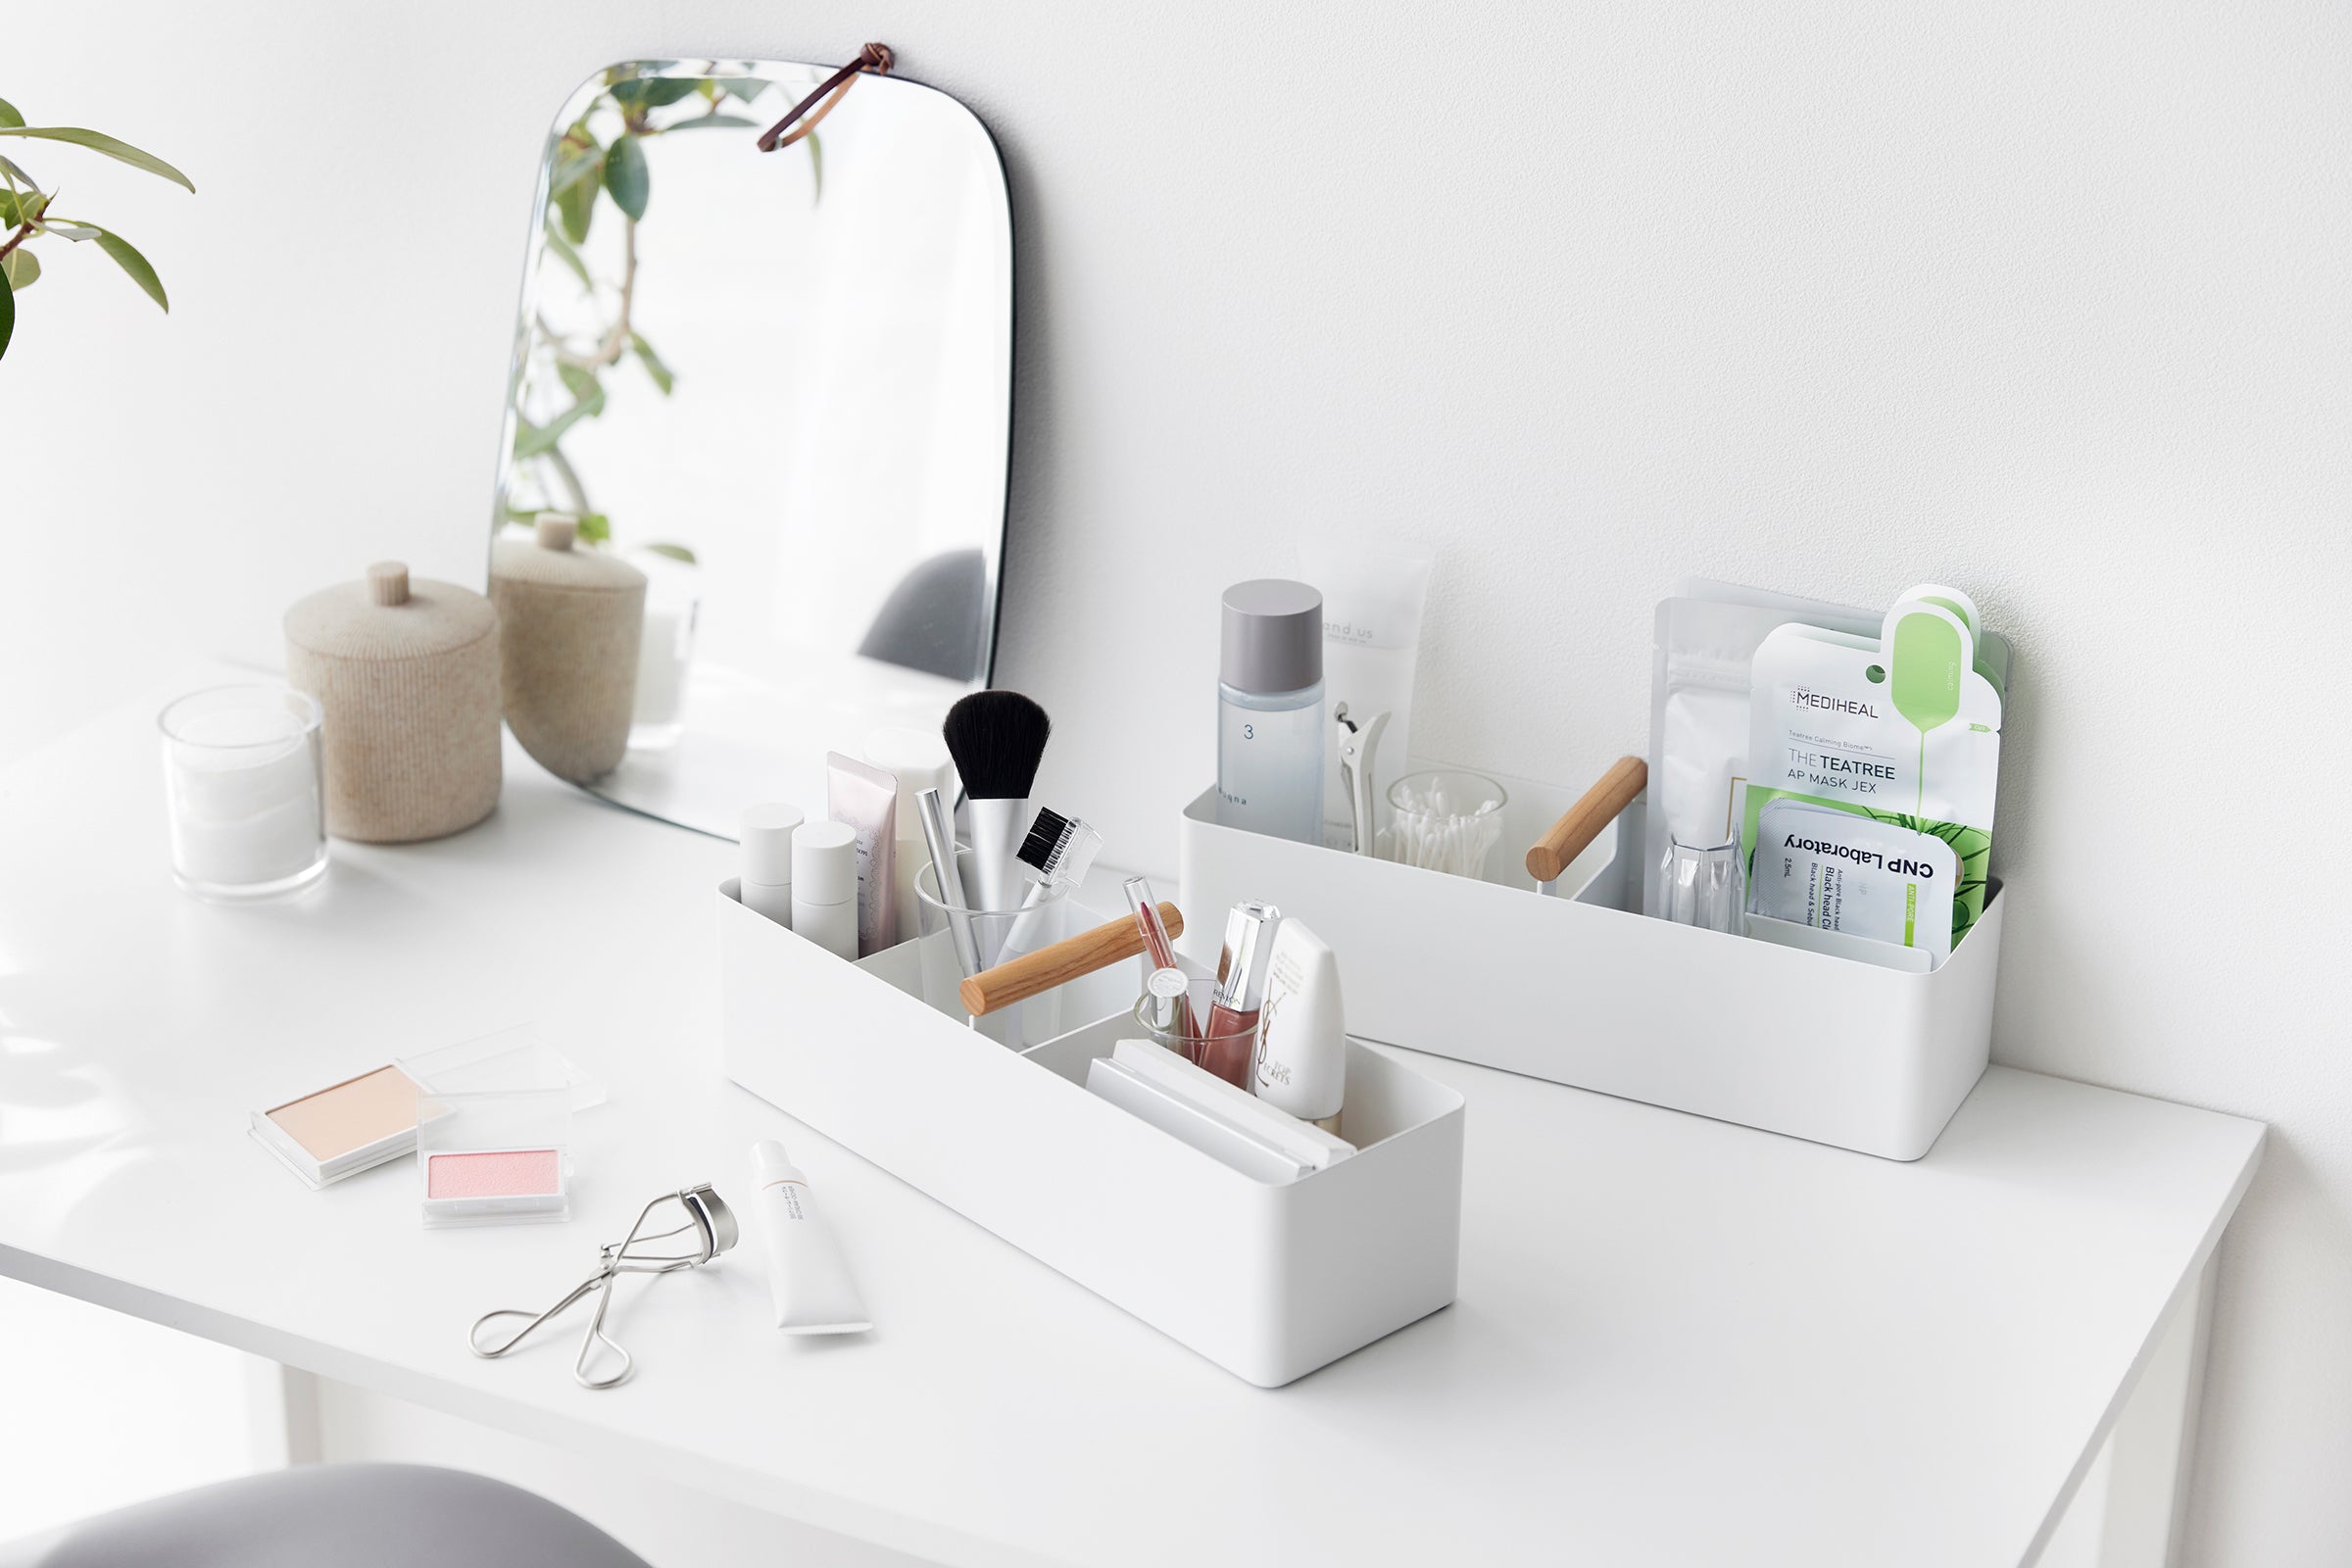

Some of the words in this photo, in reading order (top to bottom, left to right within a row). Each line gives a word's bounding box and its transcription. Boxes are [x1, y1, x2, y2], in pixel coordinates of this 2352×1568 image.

[1946, 661, 1957, 691] calming
[1796, 692, 1879, 719] MEDIHEAL
[1244, 723, 1254, 740] 3
[1788, 729, 1813, 742] Teatree
[1814, 735, 1841, 749] Calming
[1788, 748, 1818, 768] THE
[1819, 755, 1896, 781] TEATREE
[1788, 768, 1805, 780] AP
[1809, 773, 1848, 790] MASK
[1851, 781, 1878, 794] JEX
[1784, 834, 1884, 870] Laboratory
[1809, 862, 1818, 883] Black
[1824, 866, 1836, 893] Black
[1887, 858, 1935, 879] CNP
[1835, 868, 1843, 898] Anti-pore
[1822, 894, 1834, 918] head
[1834, 898, 1842, 915] Black
[1906, 884, 1915, 923] ANTI-PORE
